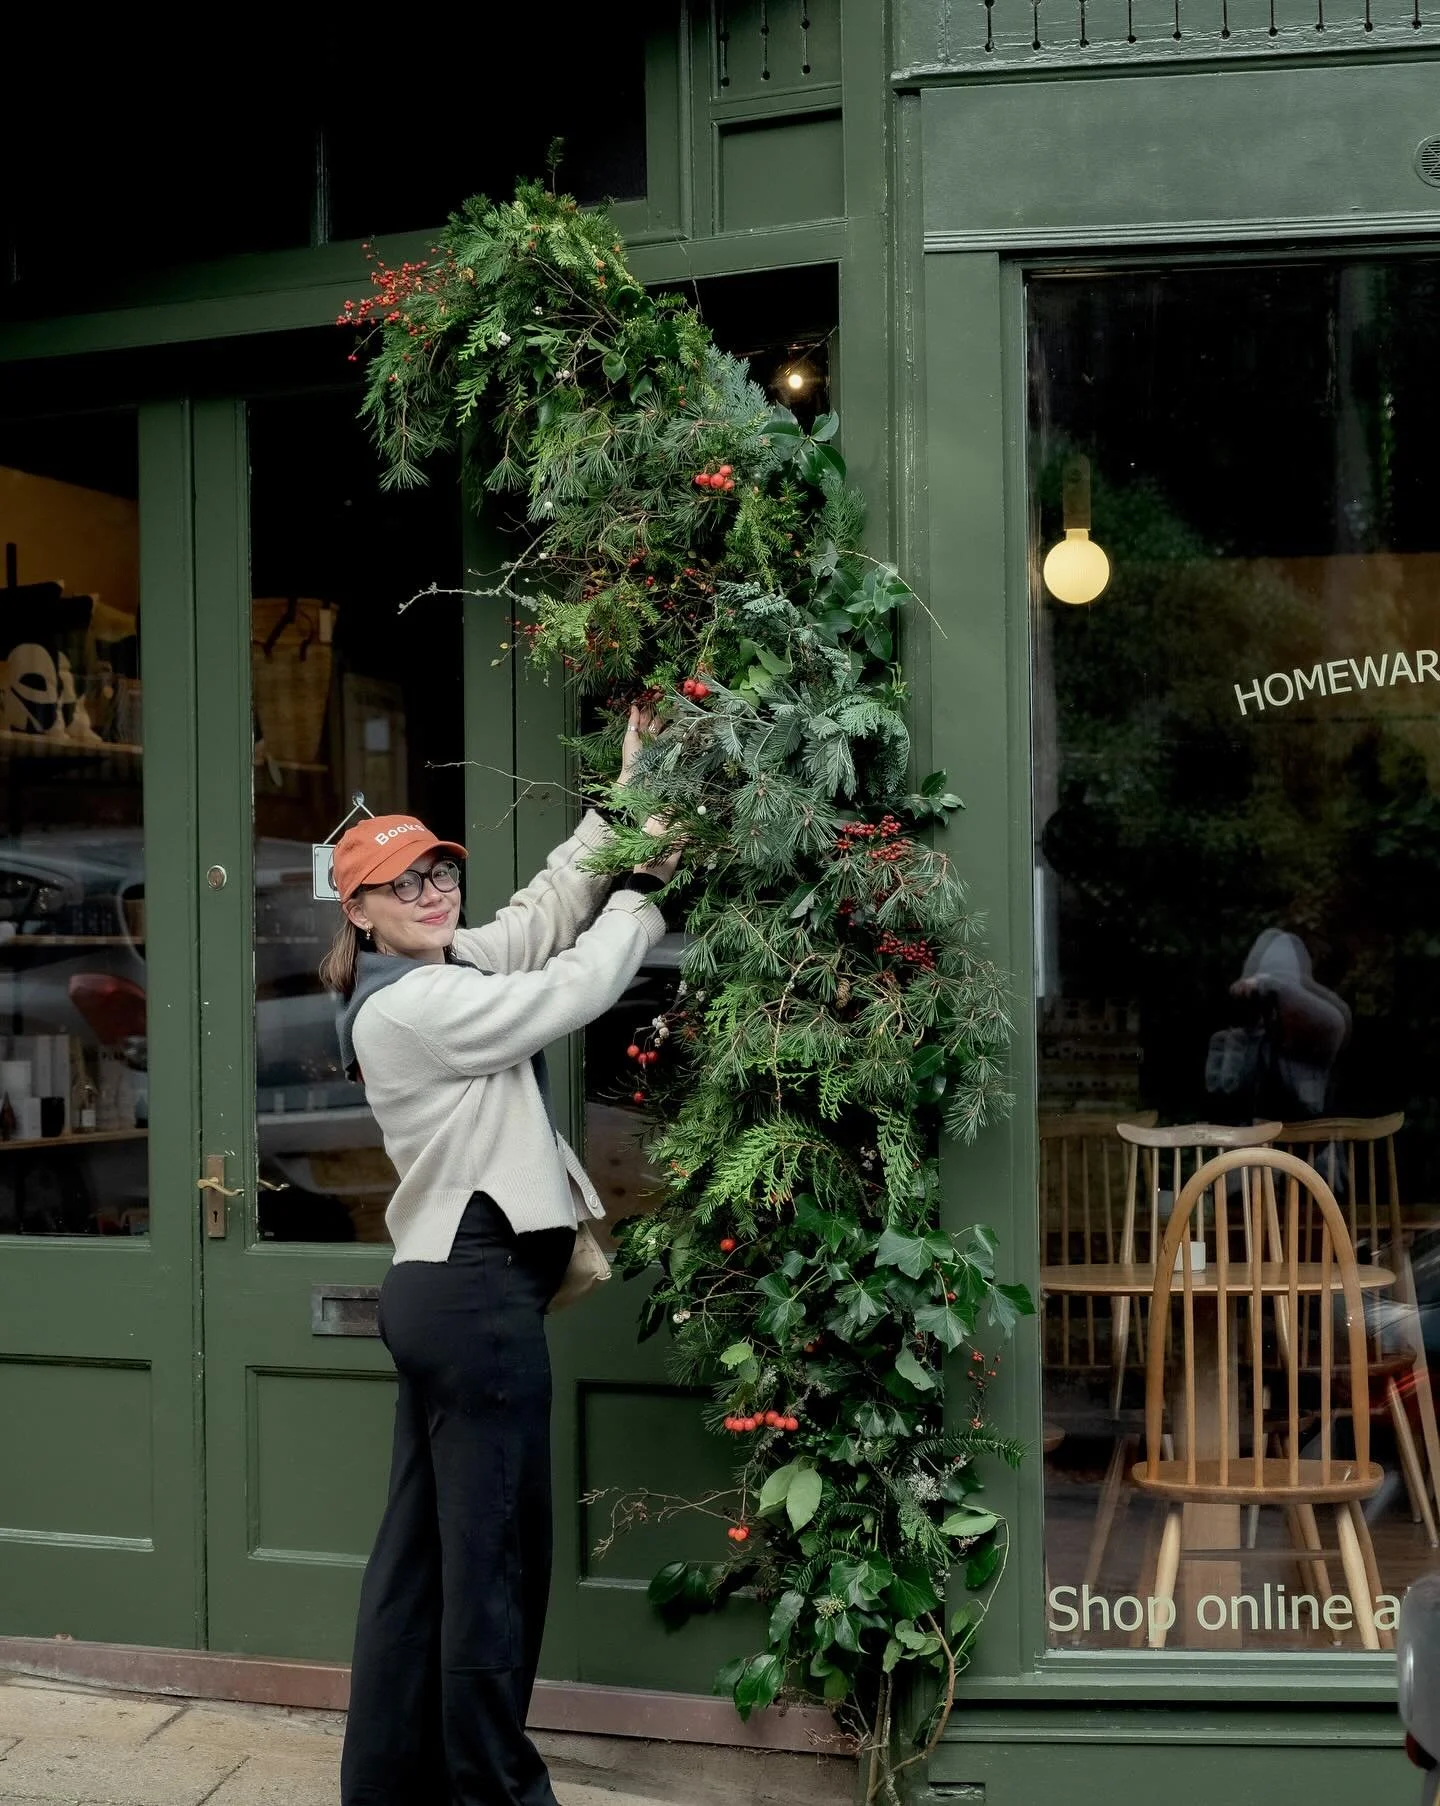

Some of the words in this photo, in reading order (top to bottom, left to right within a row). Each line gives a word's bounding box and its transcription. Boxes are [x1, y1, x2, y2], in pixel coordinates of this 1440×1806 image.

[1048, 1584, 1176, 1642] Shop
[1196, 1583, 1353, 1632] online
[1374, 1589, 1408, 1631] a
